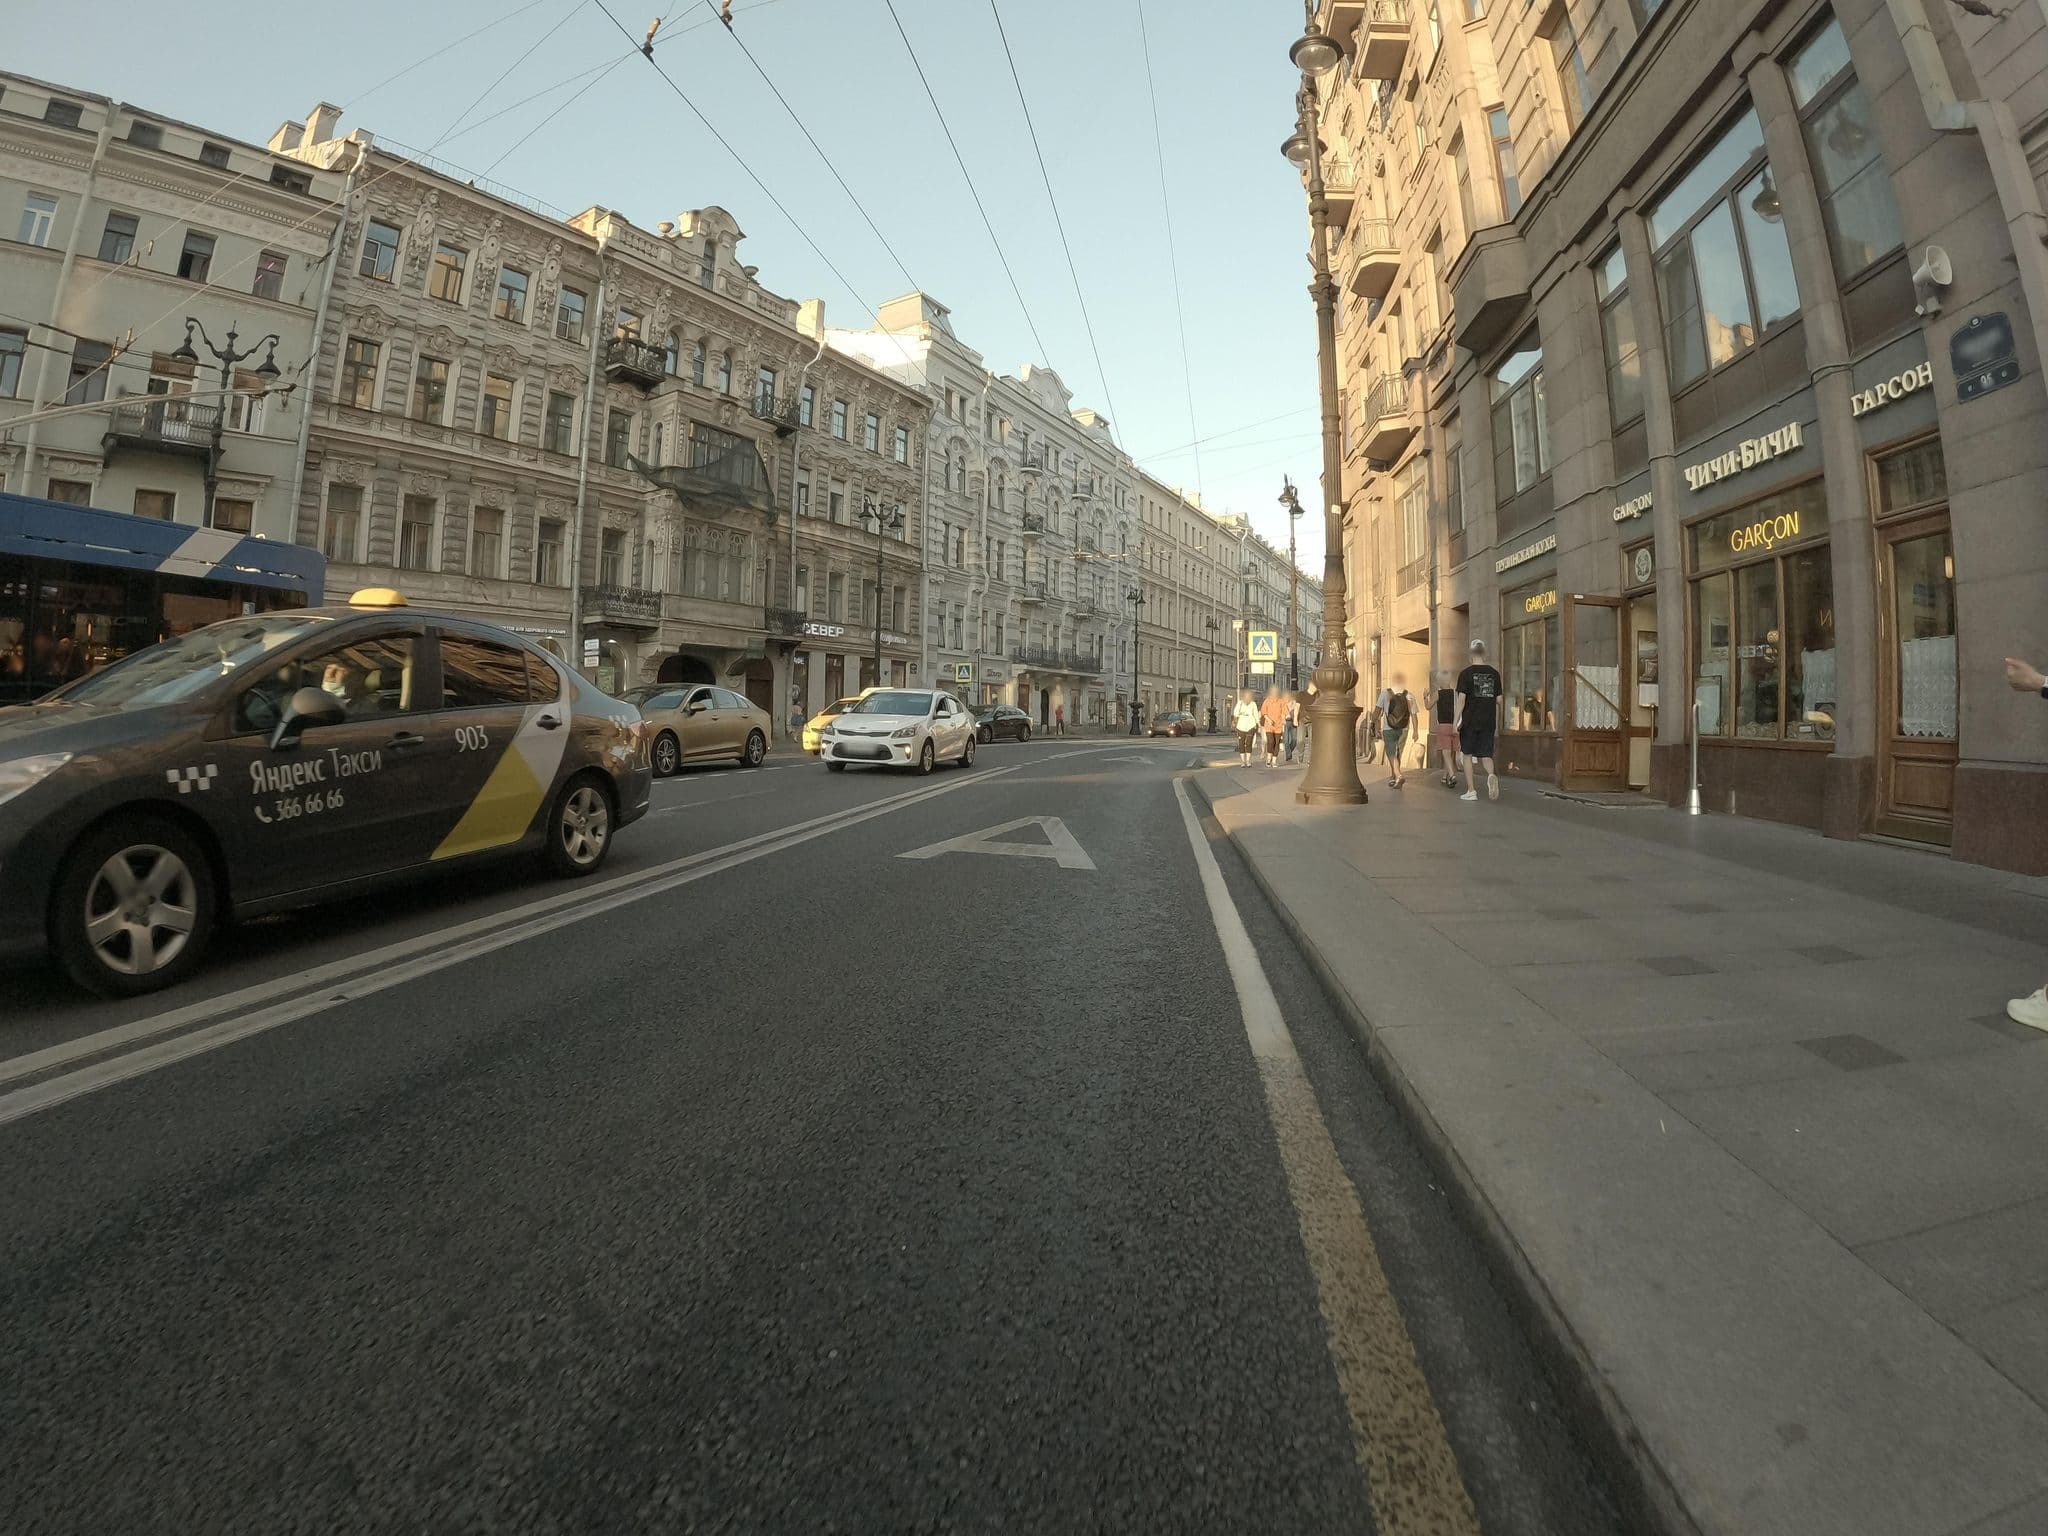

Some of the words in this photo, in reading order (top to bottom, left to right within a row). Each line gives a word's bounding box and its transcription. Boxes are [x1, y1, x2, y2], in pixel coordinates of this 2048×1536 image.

[1850, 361, 1933, 417] ГАРСОН
[1613, 492, 1653, 521] GARÇON
[1535, 534, 1557, 555] КУХН
[1731, 511, 1800, 552] GARÇON
[1525, 590, 1556, 612] GARÇON
[802, 622, 845, 637] СЕВЕР
[455, 725, 489, 753] 903
[250, 758, 327, 795] Яндекс
[327, 747, 382, 778] Такси
[275, 796, 302, 821] 366
[304, 792, 324, 814] 66
[327, 788, 344, 810] 66
